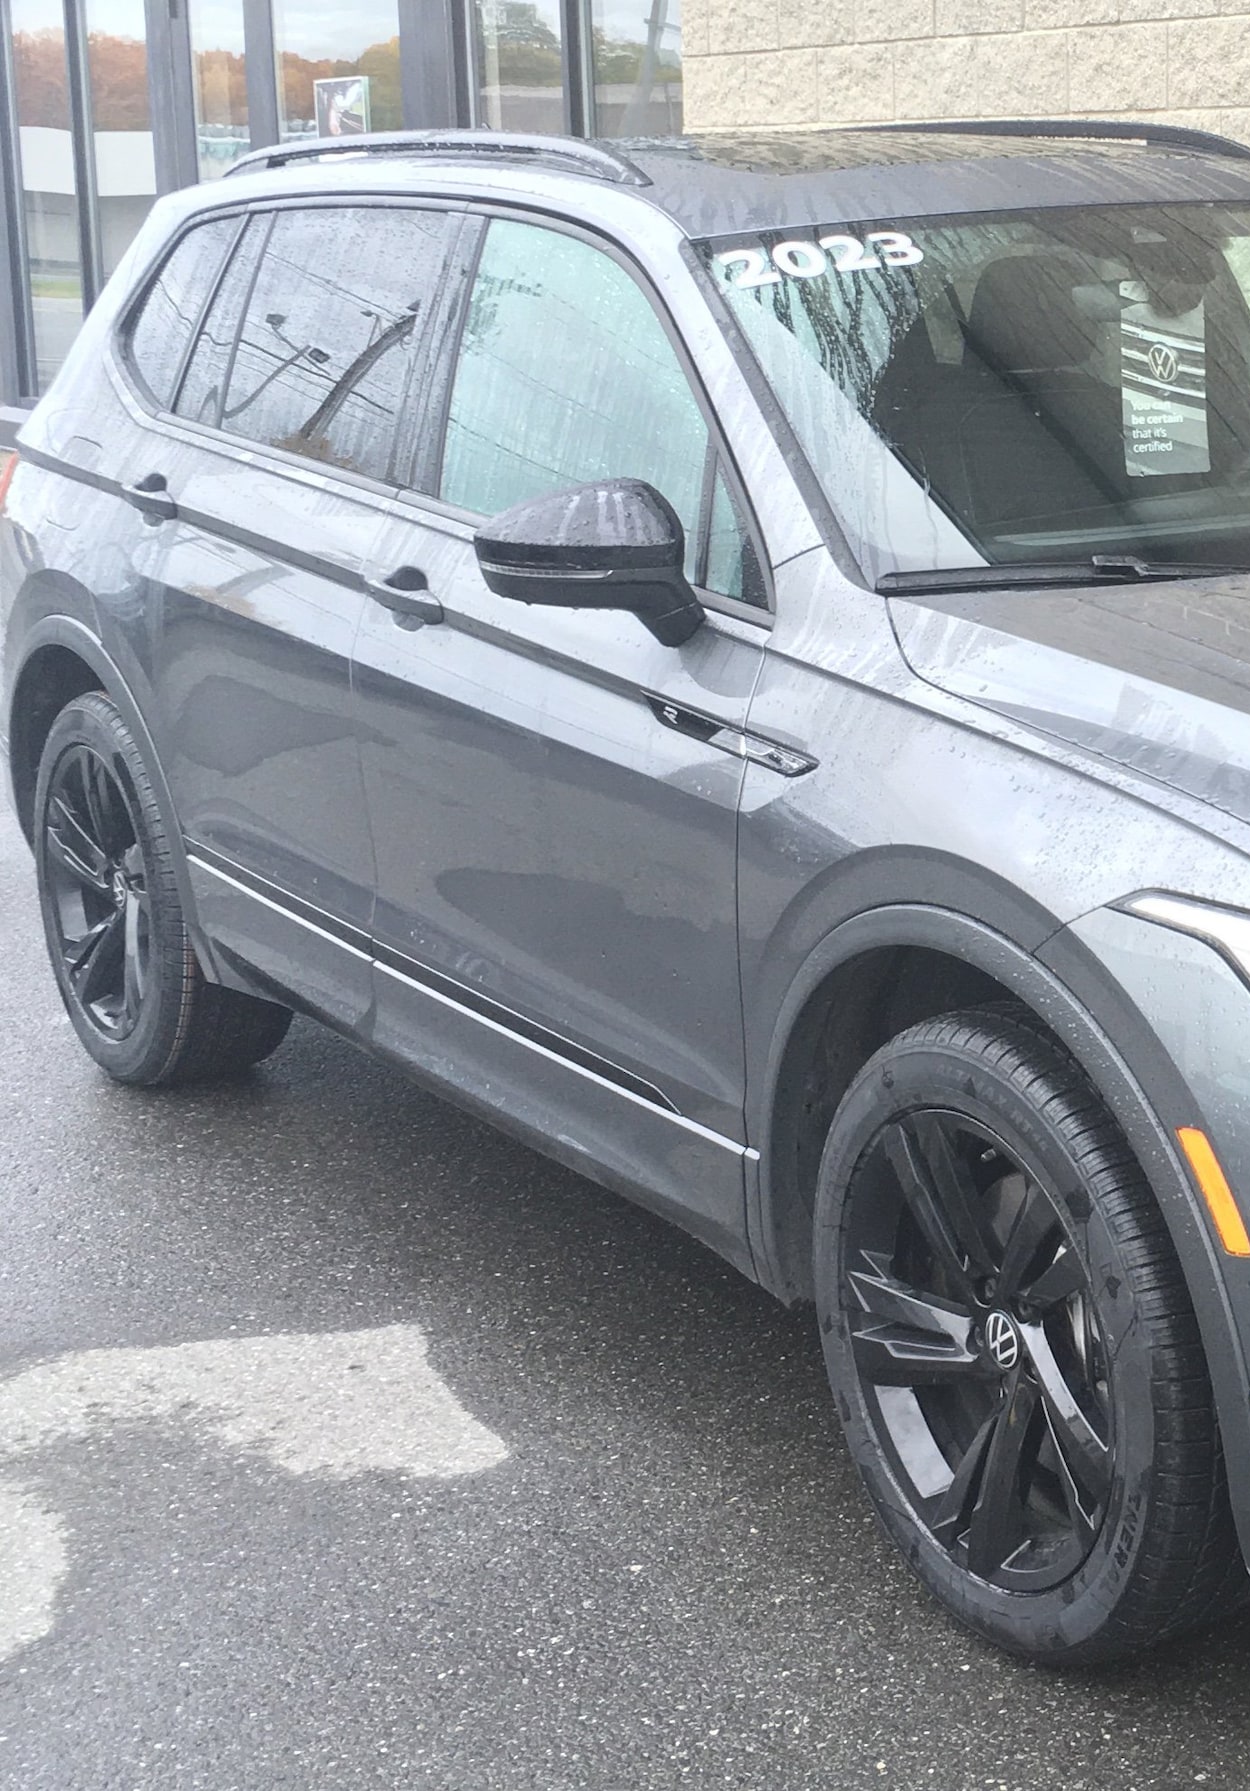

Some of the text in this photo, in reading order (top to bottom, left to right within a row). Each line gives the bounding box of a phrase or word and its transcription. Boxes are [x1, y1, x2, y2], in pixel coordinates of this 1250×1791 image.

[717, 231, 924, 289] 2023
[1131, 412, 1183, 424] be certain
[1132, 429, 1151, 438] that
[1133, 441, 1172, 452] certified
